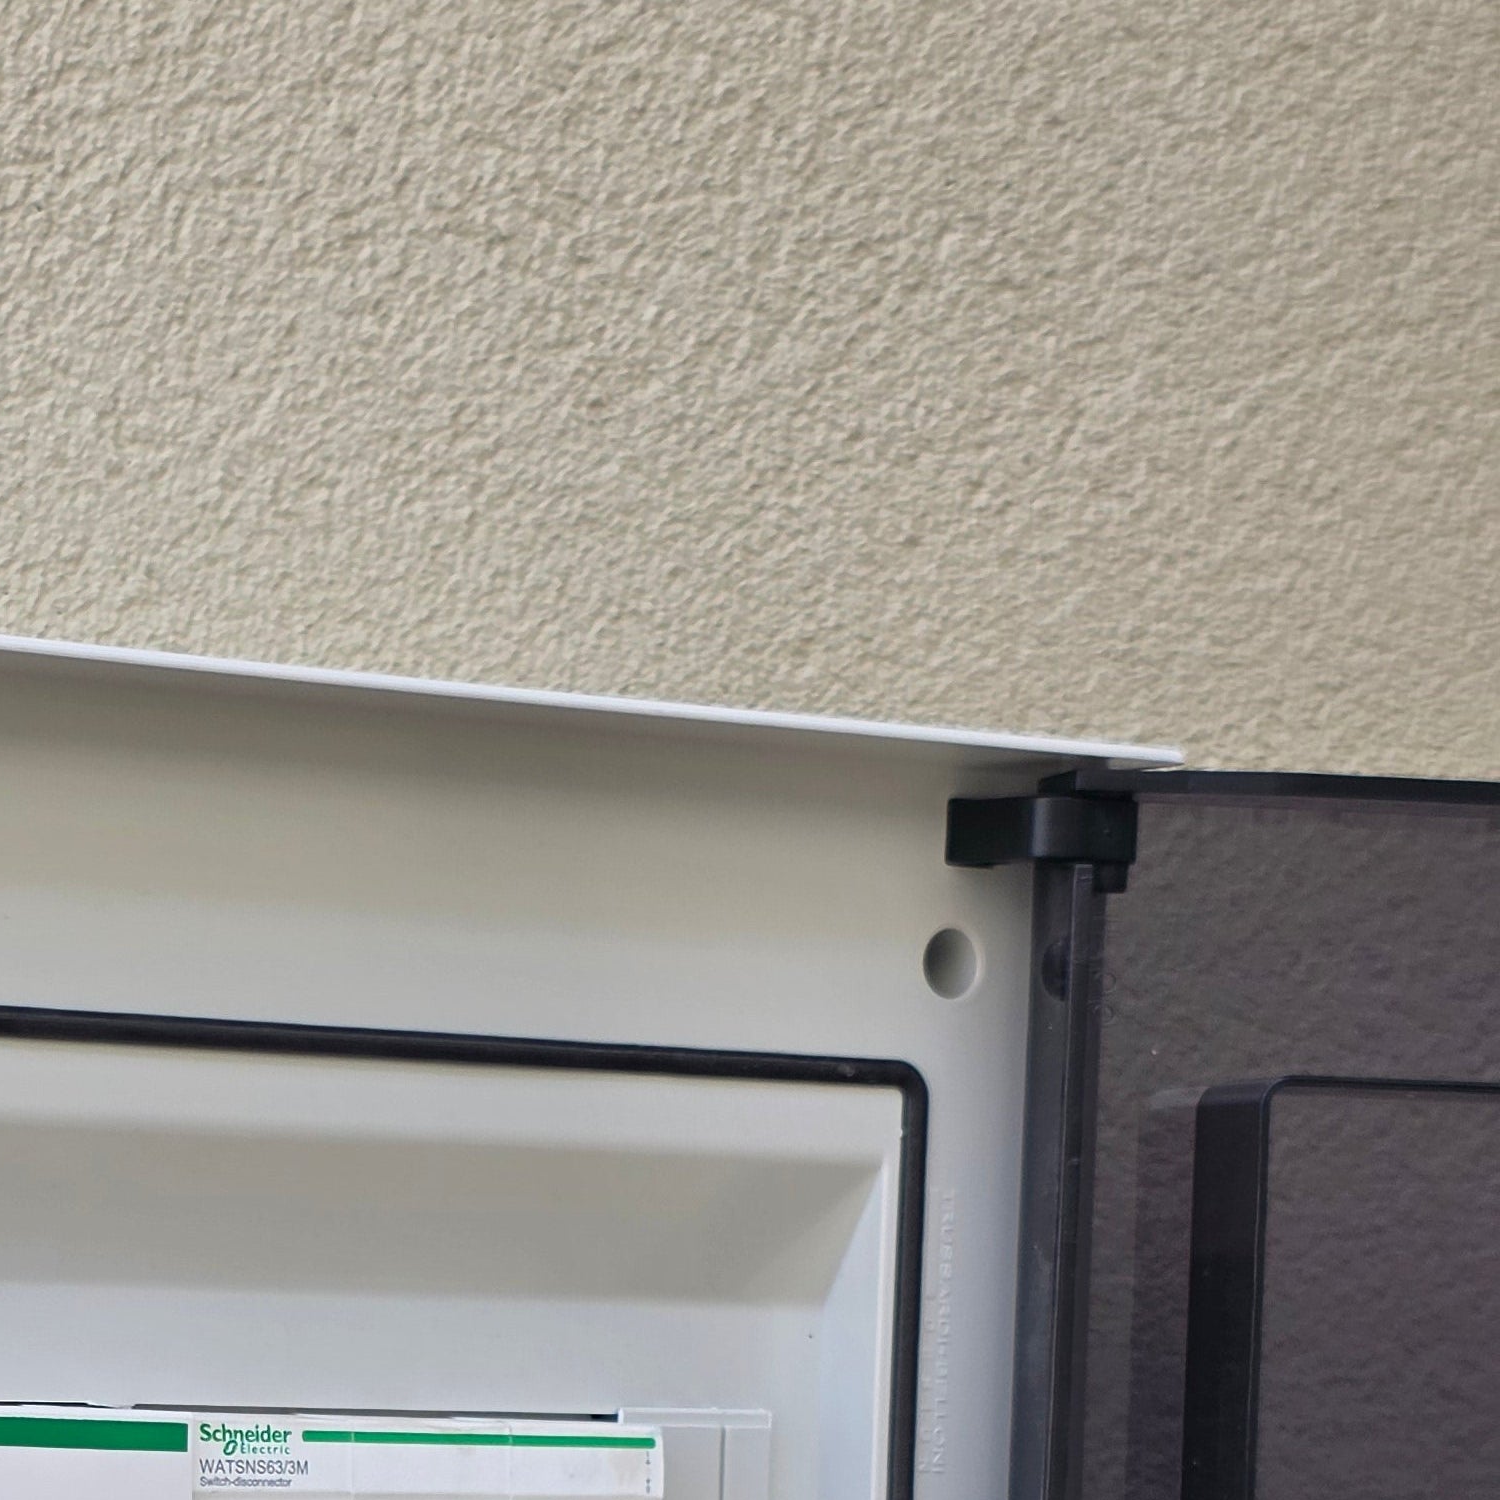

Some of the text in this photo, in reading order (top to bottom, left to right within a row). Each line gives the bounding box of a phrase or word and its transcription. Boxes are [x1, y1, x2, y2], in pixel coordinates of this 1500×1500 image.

[199, 1423, 293, 1443] Schneider
[240, 1442, 291, 1455] Electric
[199, 1458, 309, 1475] WATSNS63/3M
[199, 1476, 293, 1488] Switch-disconnector
